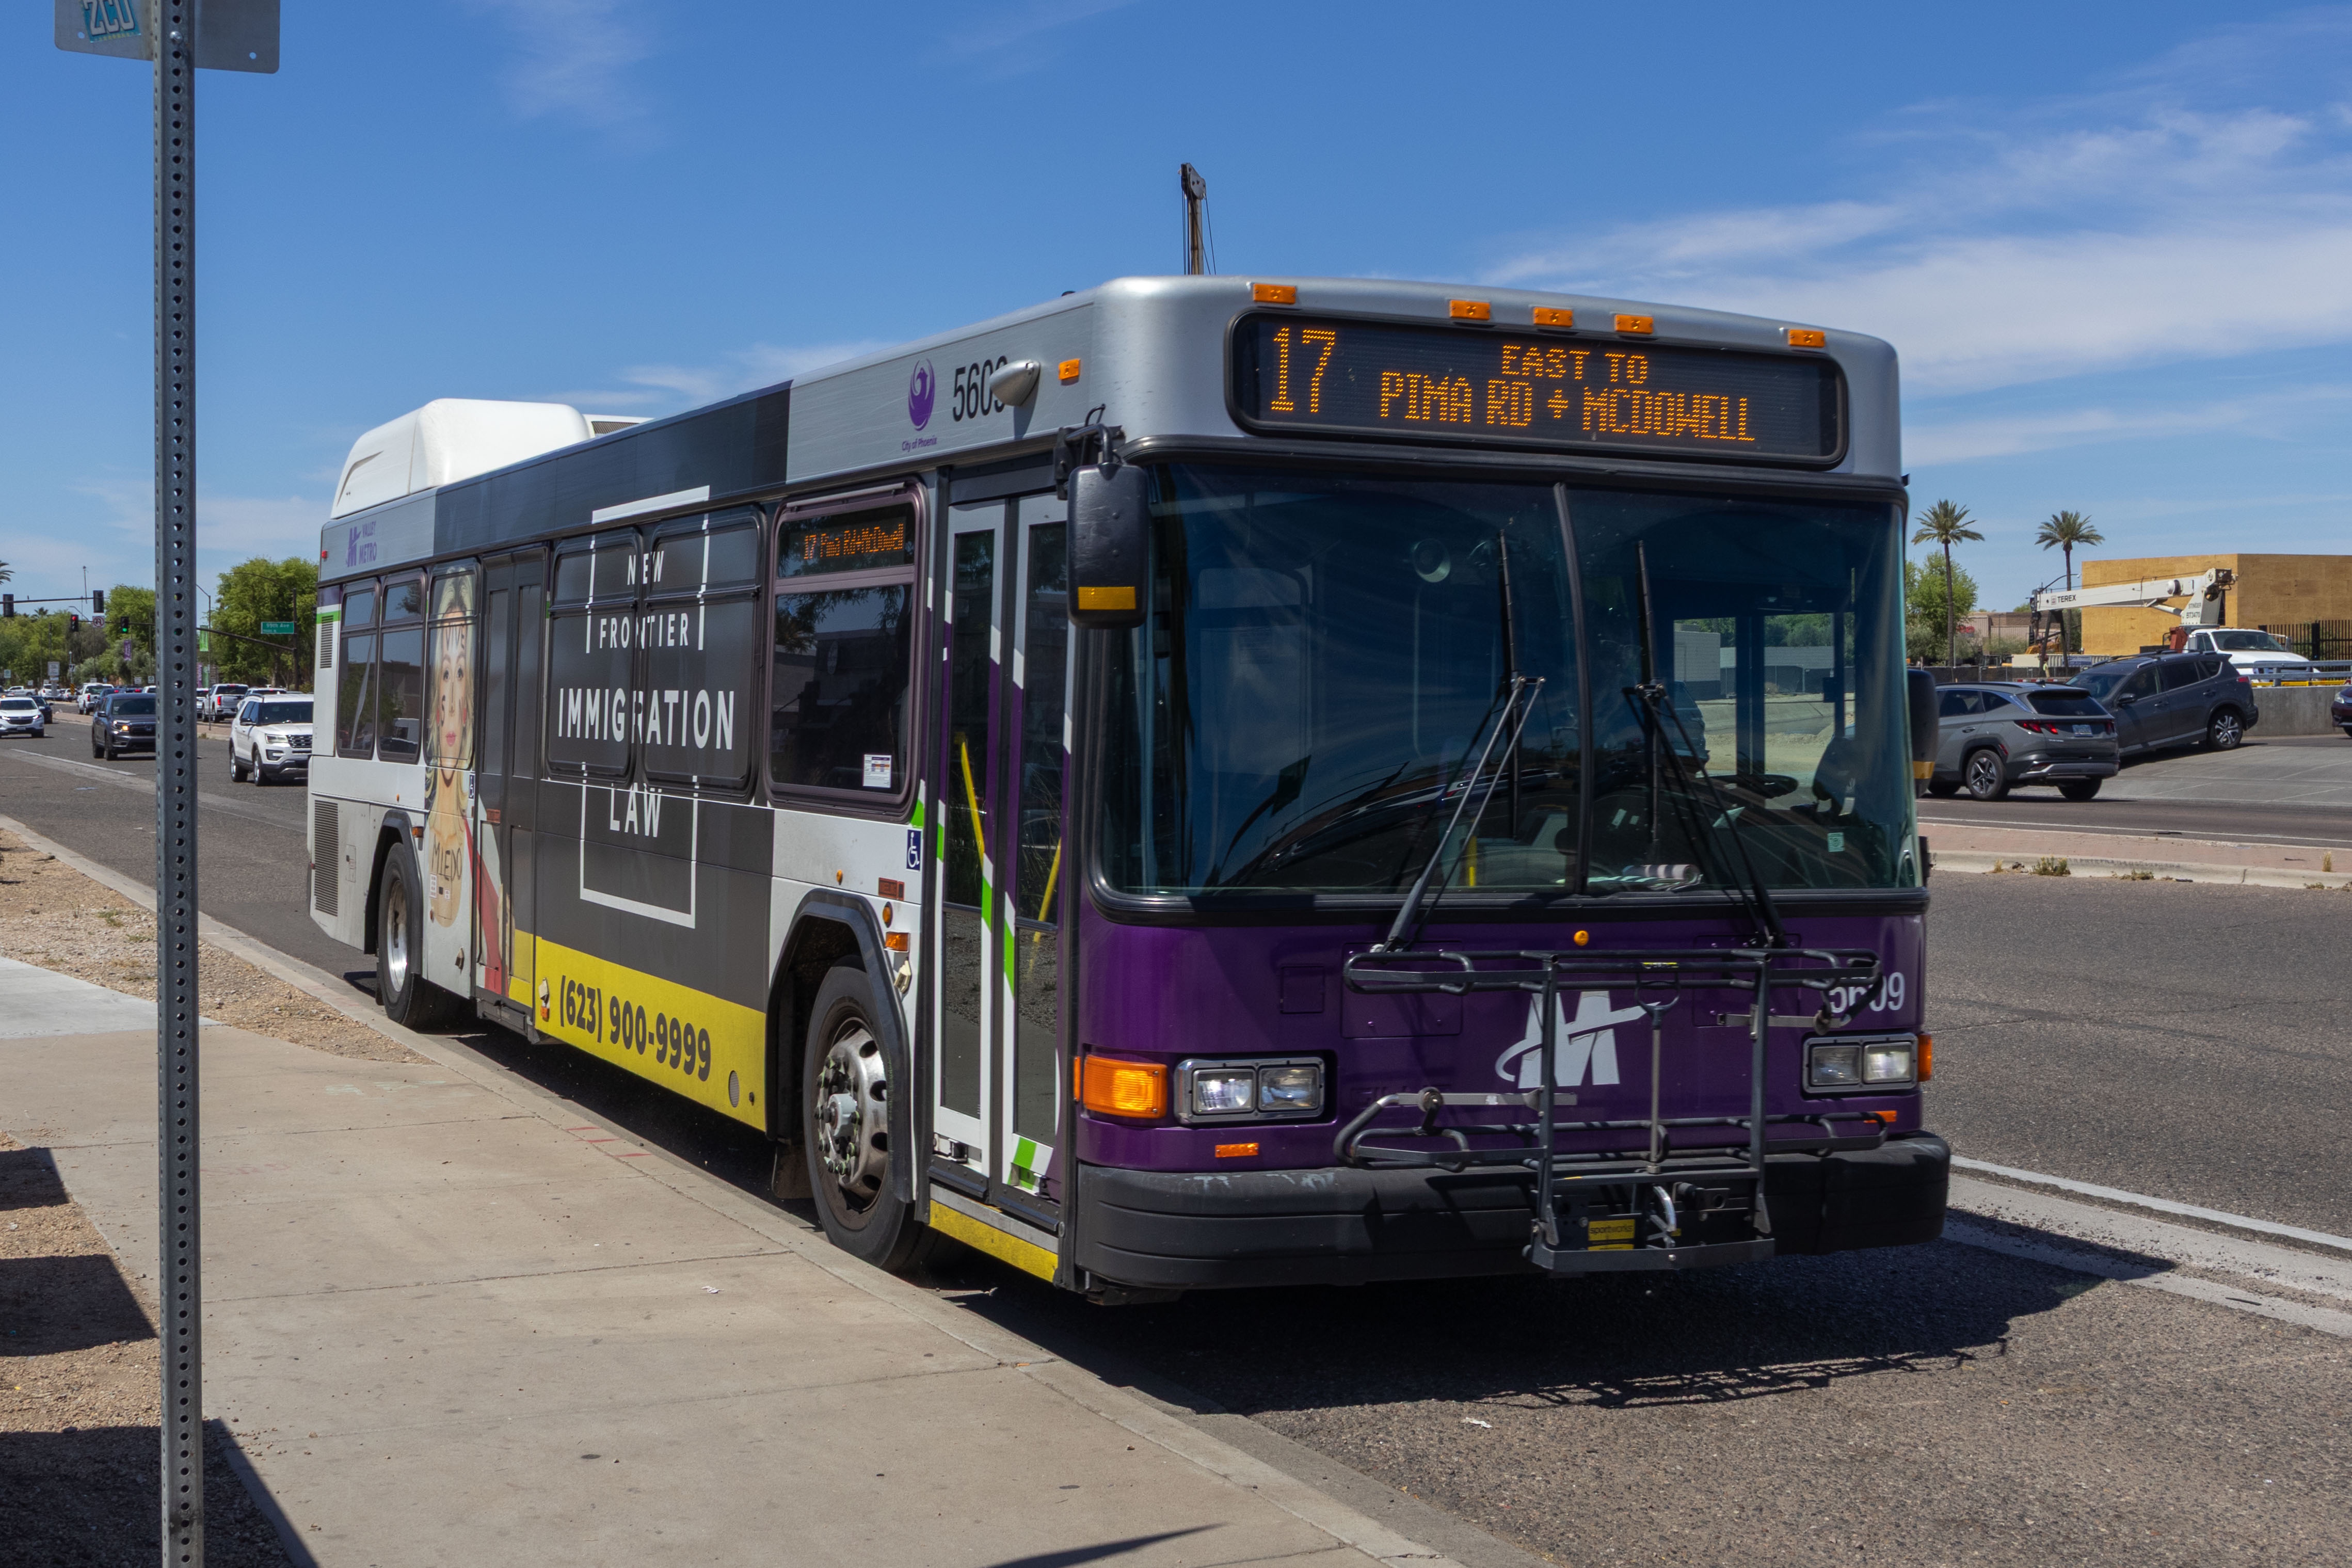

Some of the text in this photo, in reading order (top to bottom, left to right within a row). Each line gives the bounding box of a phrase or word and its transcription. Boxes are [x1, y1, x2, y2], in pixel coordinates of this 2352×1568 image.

[1270, 327, 1336, 413] 17
[1501, 345, 1649, 385] EAST TO
[1380, 371, 1473, 423] PIMA
[1486, 379, 1533, 427] RD
[1582, 386, 1755, 442] MCDOWELL
[902, 435, 937, 453] City of Phoenix
[362, 520, 376, 537] VALLEY
[804, 534, 817, 560] 17
[820, 533, 841, 558] Pima
[359, 541, 377, 565] METRO
[627, 550, 665, 586] NEW
[2057, 594, 2076, 603] TEREX
[599, 613, 690, 649] FRONTIER
[558, 687, 735, 751] IMMIGRATION
[609, 781, 663, 838] LAW
[431, 836, 462, 881] MIEDO
[559, 974, 712, 1082] (623) 900-9999
